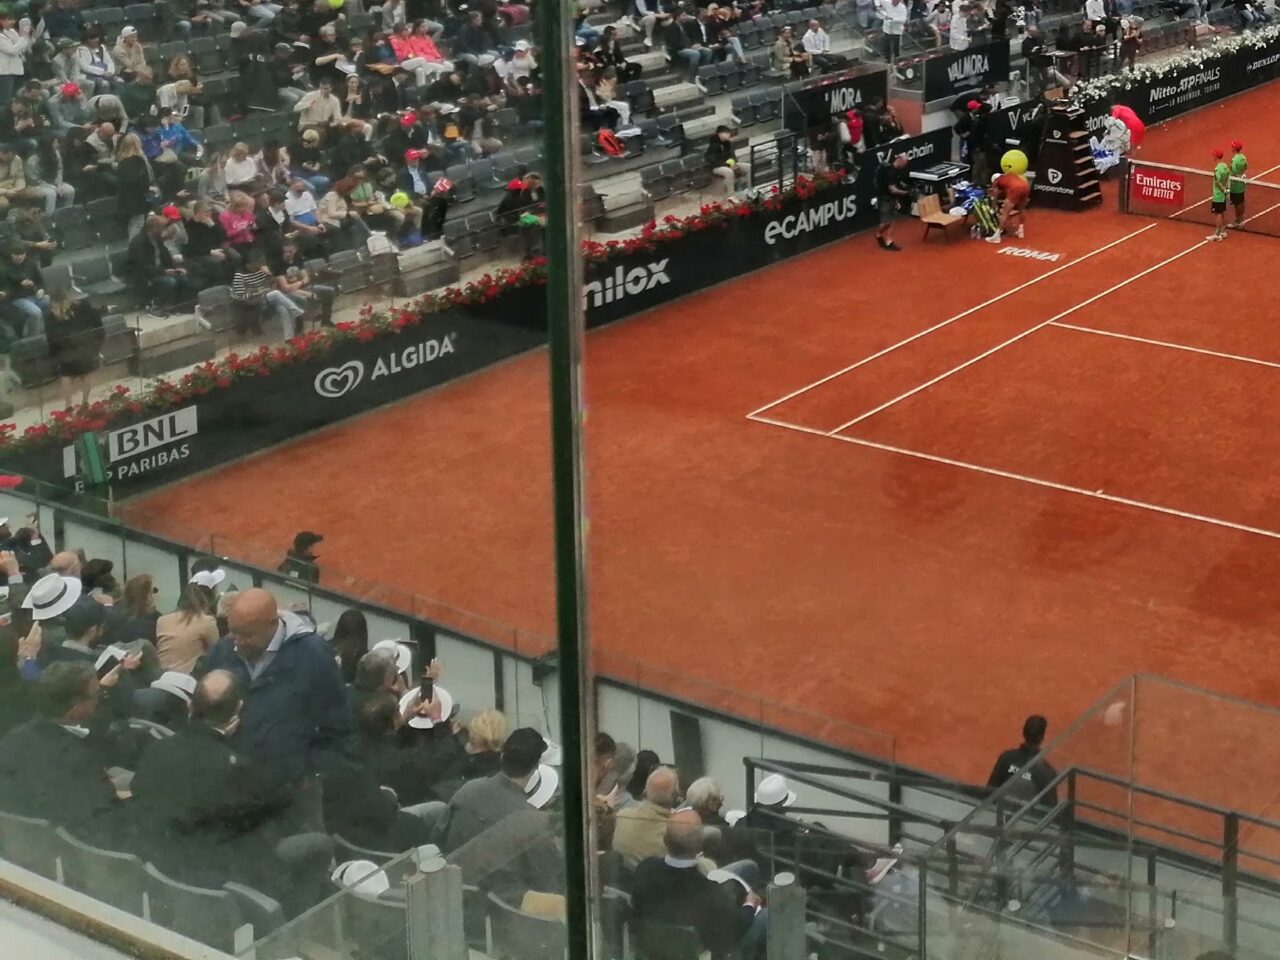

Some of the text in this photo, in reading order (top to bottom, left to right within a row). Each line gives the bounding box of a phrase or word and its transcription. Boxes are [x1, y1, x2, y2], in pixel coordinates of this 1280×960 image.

[1149, 86, 1177, 103] Nitto
[1033, 184, 1075, 195] pepperstone
[1136, 174, 1181, 191] Emirates
[1142, 186, 1175, 200] FLY BETTER
[997, 246, 1061, 262] ROMA
[371, 335, 455, 381] ALGIDA
[117, 415, 188, 456] BNL
[118, 444, 191, 480] PARIBAS
